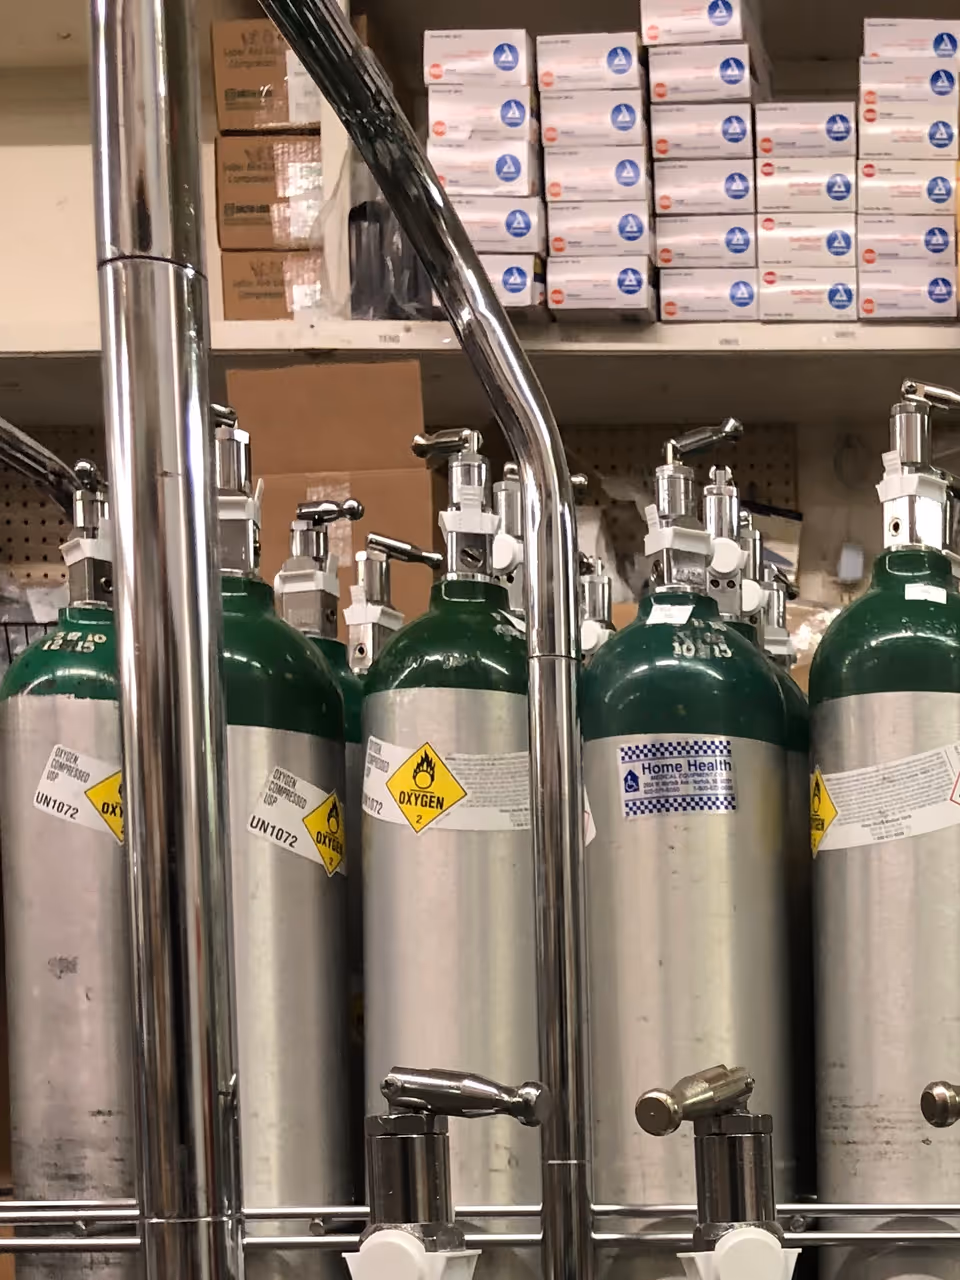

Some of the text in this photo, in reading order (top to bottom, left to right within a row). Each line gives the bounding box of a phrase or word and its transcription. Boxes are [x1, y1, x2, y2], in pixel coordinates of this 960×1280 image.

[46, 769, 60, 782] USP
[51, 758, 91, 784] COMPRESSED
[641, 759, 732, 776] Home Health
[263, 792, 278, 807] USP
[267, 780, 308, 810] COMPRESSED
[398, 790, 445, 811] OXYGEN
[35, 791, 79, 821] UN1072
[415, 814, 423, 825] 2
[249, 815, 298, 849] UN1072
[315, 830, 344, 856] OXYGEN
[328, 856, 334, 866] 2
